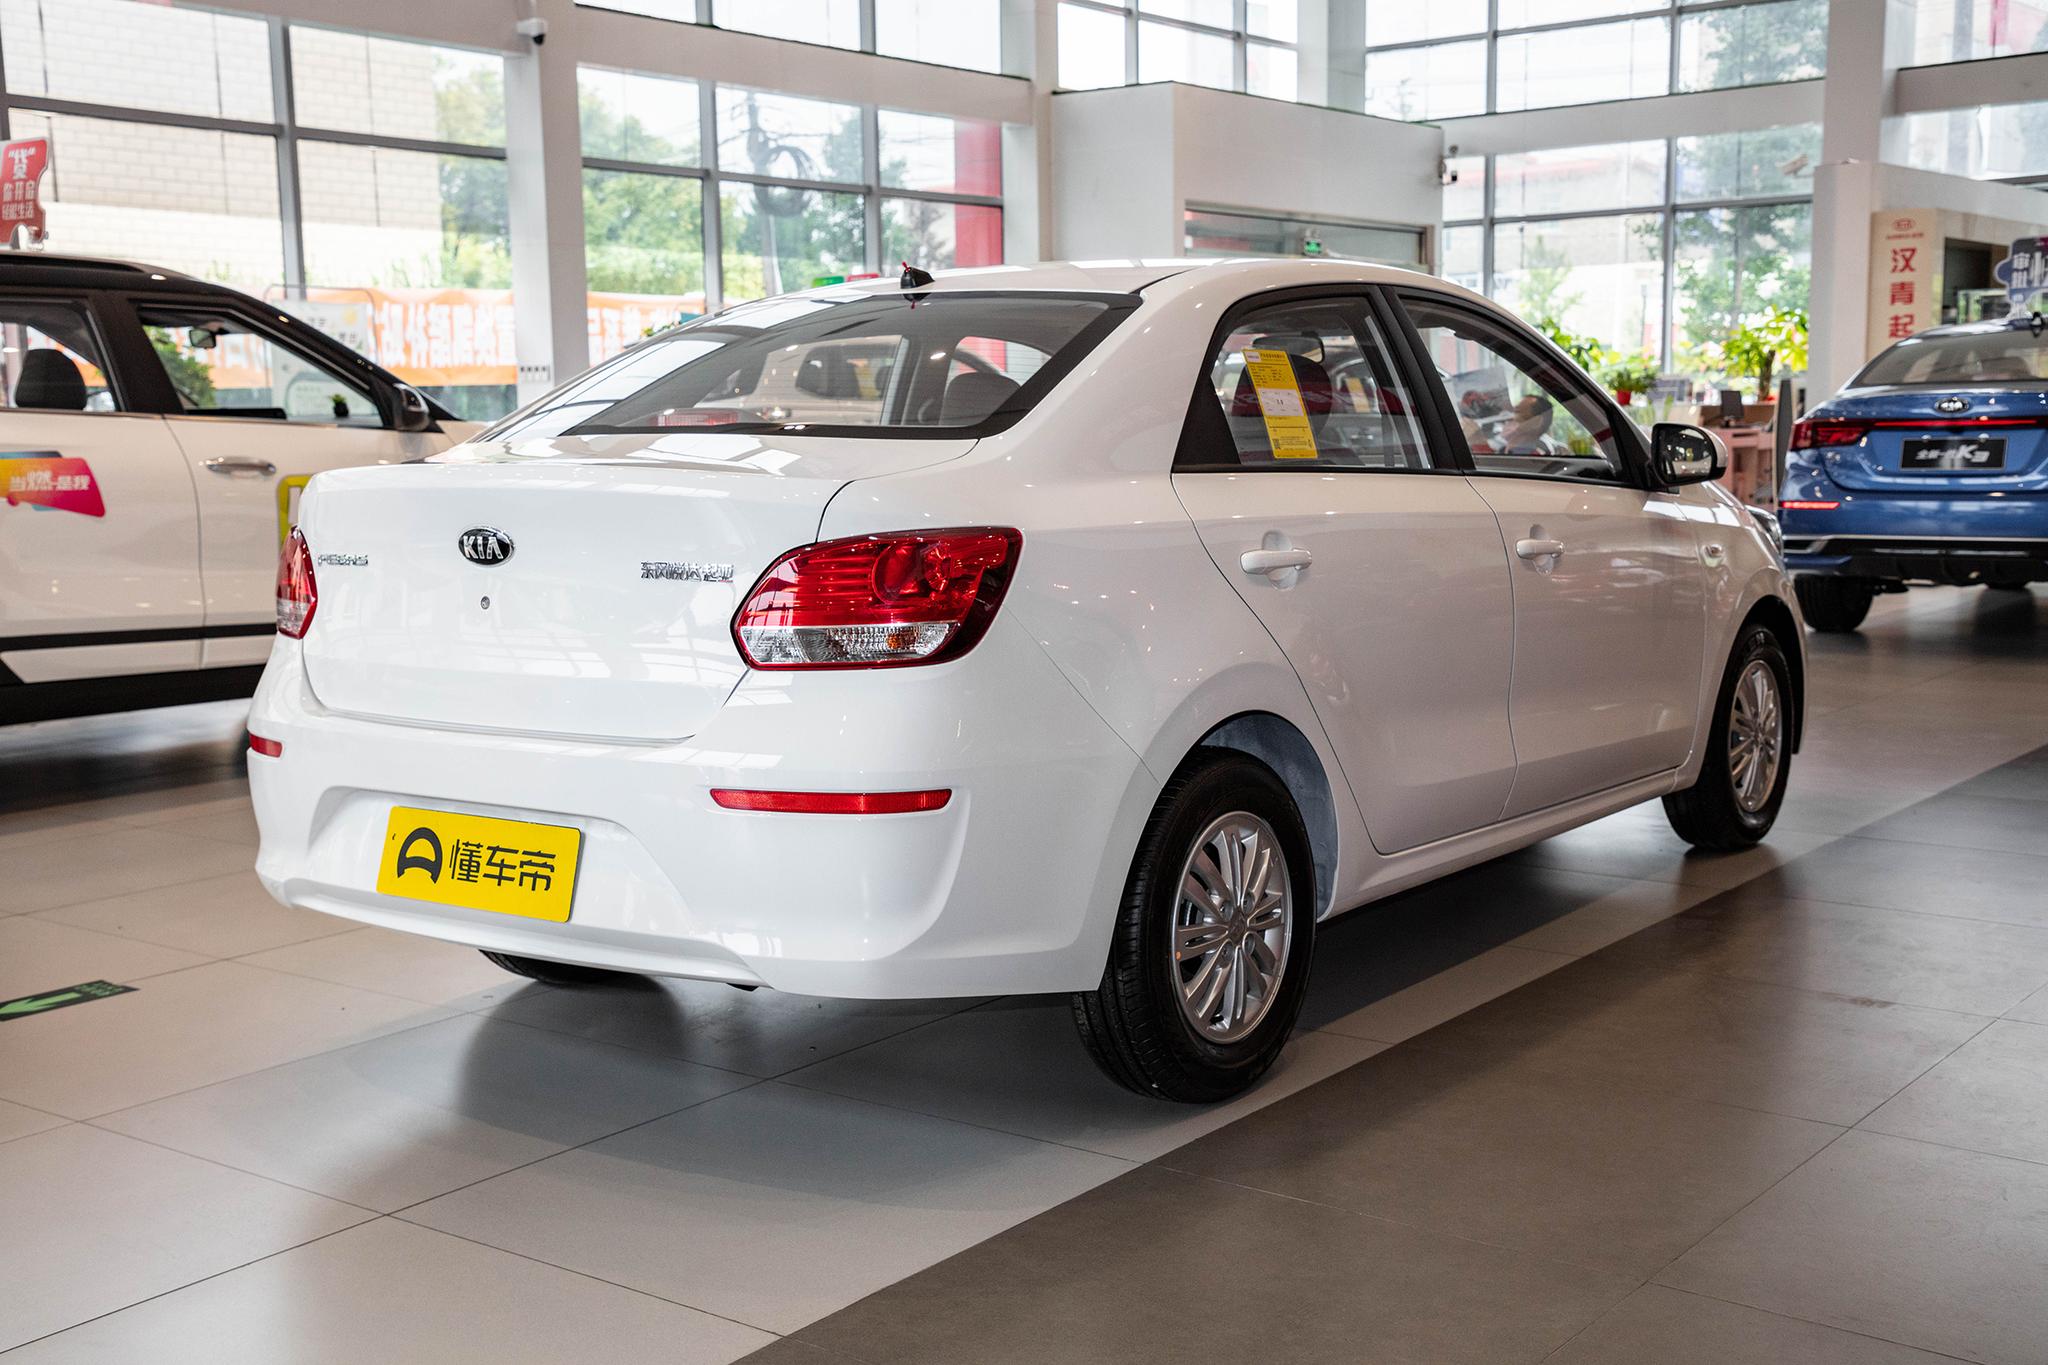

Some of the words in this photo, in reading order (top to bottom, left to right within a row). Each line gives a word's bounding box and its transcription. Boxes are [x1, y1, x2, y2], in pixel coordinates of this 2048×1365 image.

[463, 535, 504, 559] KIA
[641, 561, 734, 582] 东风悦达起亚
[449, 838, 557, 892] 懂车帝
